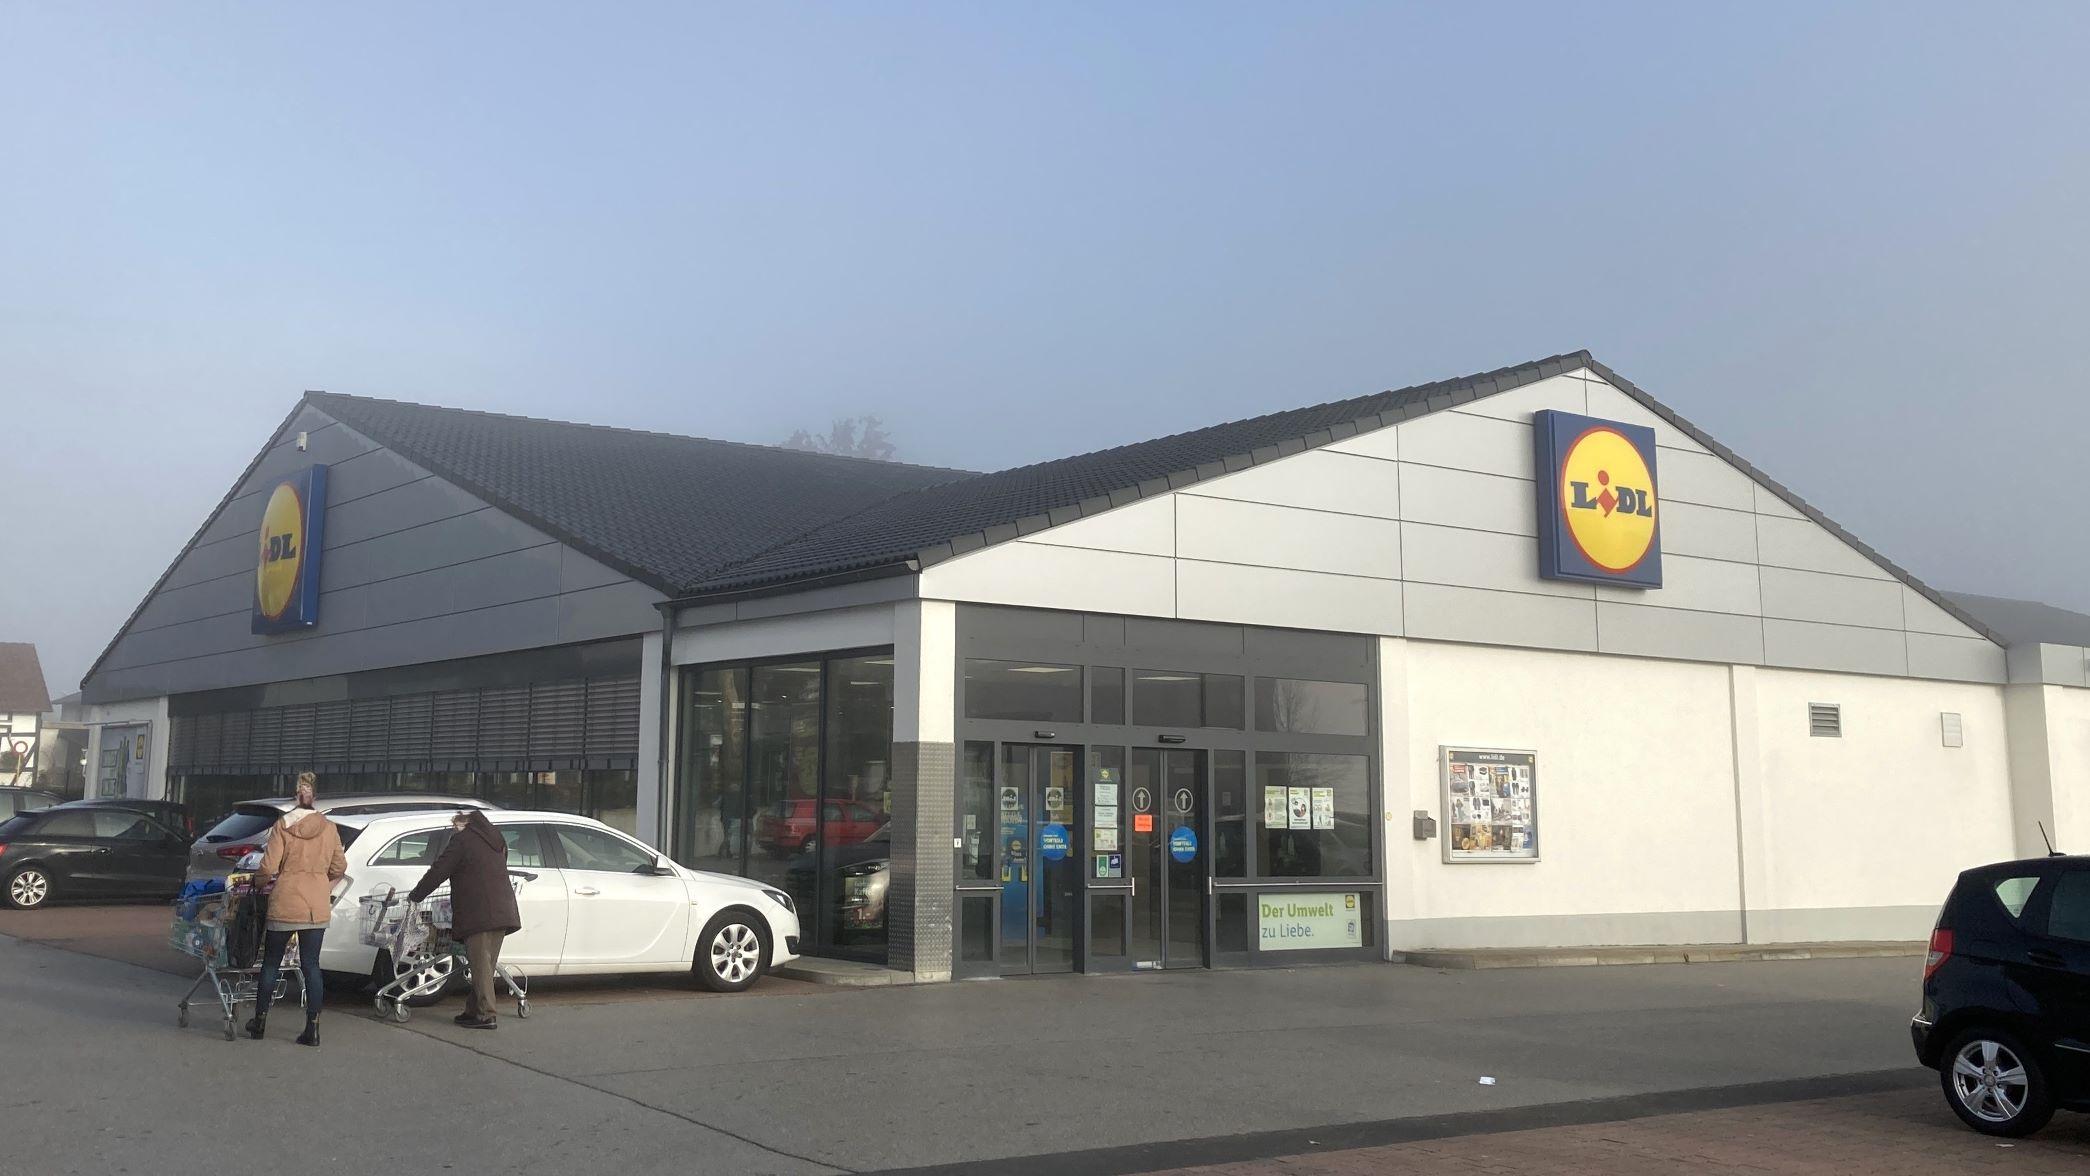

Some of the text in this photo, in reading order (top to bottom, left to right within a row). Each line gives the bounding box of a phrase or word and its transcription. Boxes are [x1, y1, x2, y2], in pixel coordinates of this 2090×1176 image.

[1261, 903, 1285, 919] Der
[1287, 902, 1334, 918] Umwelt
[1261, 922, 1315, 939] zu Liebe.
